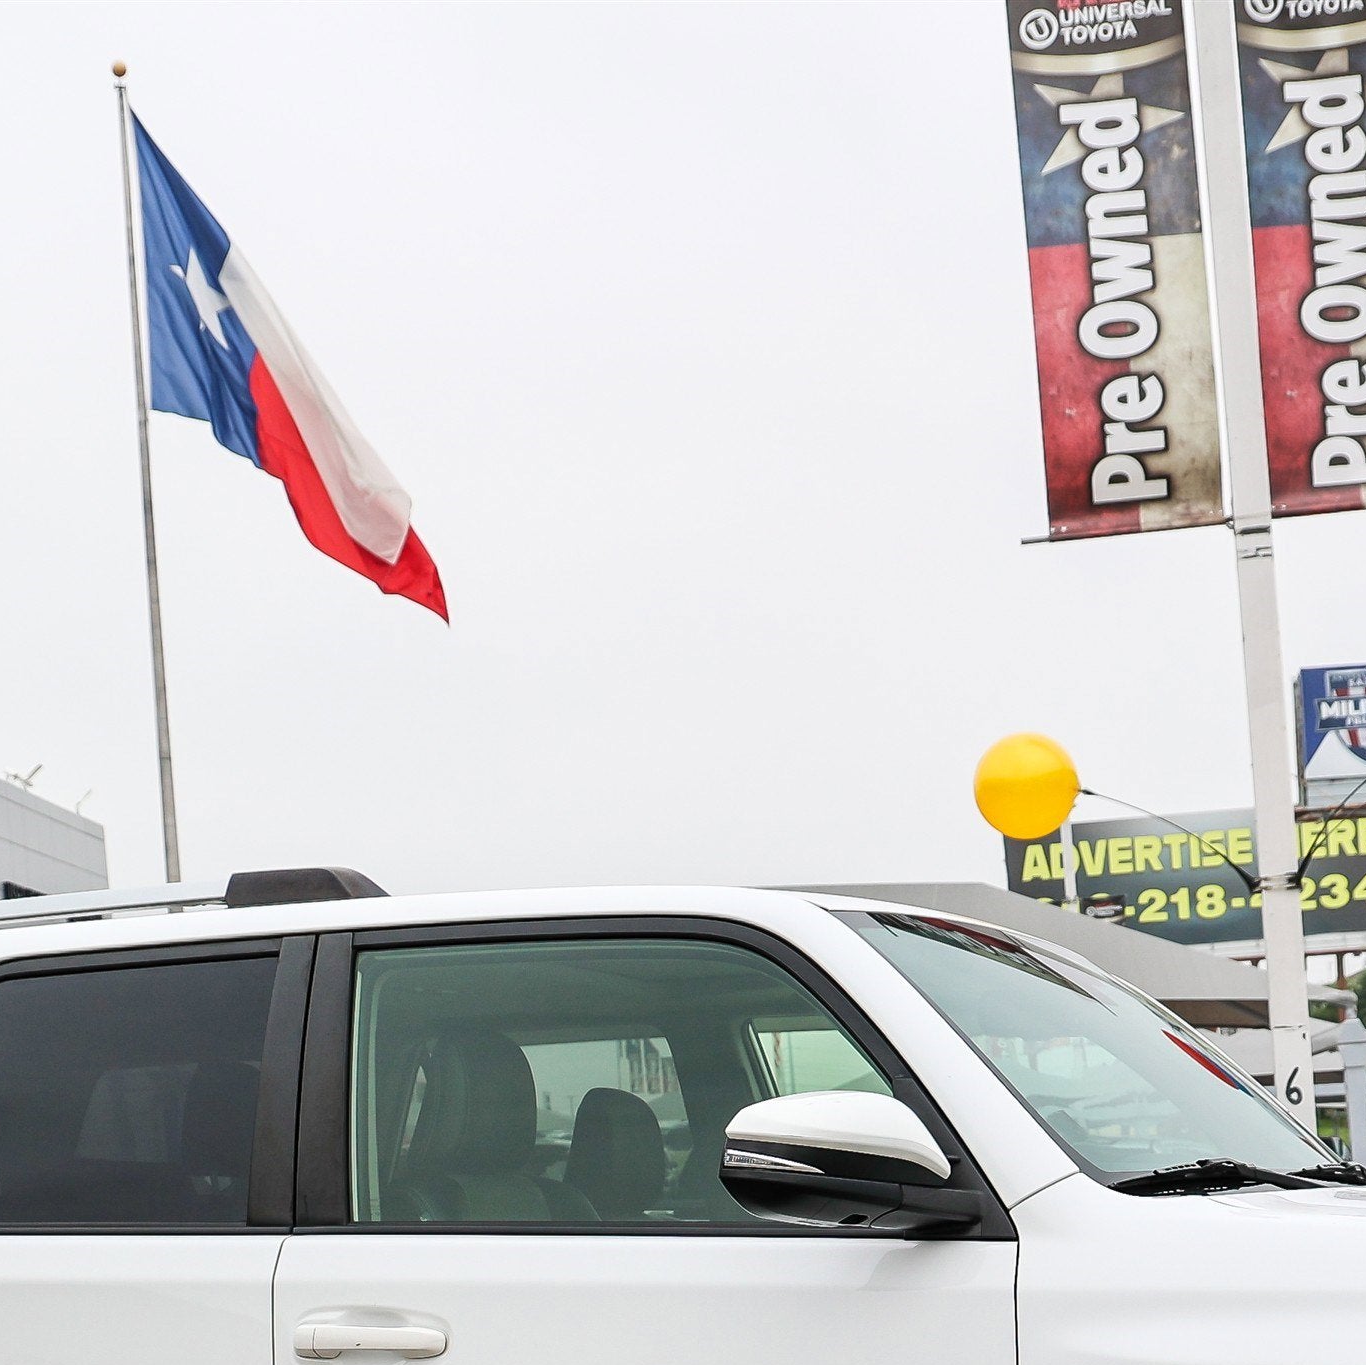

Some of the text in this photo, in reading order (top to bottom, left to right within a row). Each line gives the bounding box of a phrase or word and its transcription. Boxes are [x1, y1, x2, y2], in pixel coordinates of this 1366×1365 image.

[1059, 0, 1173, 27] UNIVERSAL
[1287, 0, 1365, 20] TOYOTA
[1060, 19, 1138, 46] TOYOTA
[1059, 97, 1161, 360] Owned
[1092, 373, 1169, 505] Pre
[1022, 827, 1254, 882] ADVERTISE
[1286, 1066, 1303, 1106] 6
